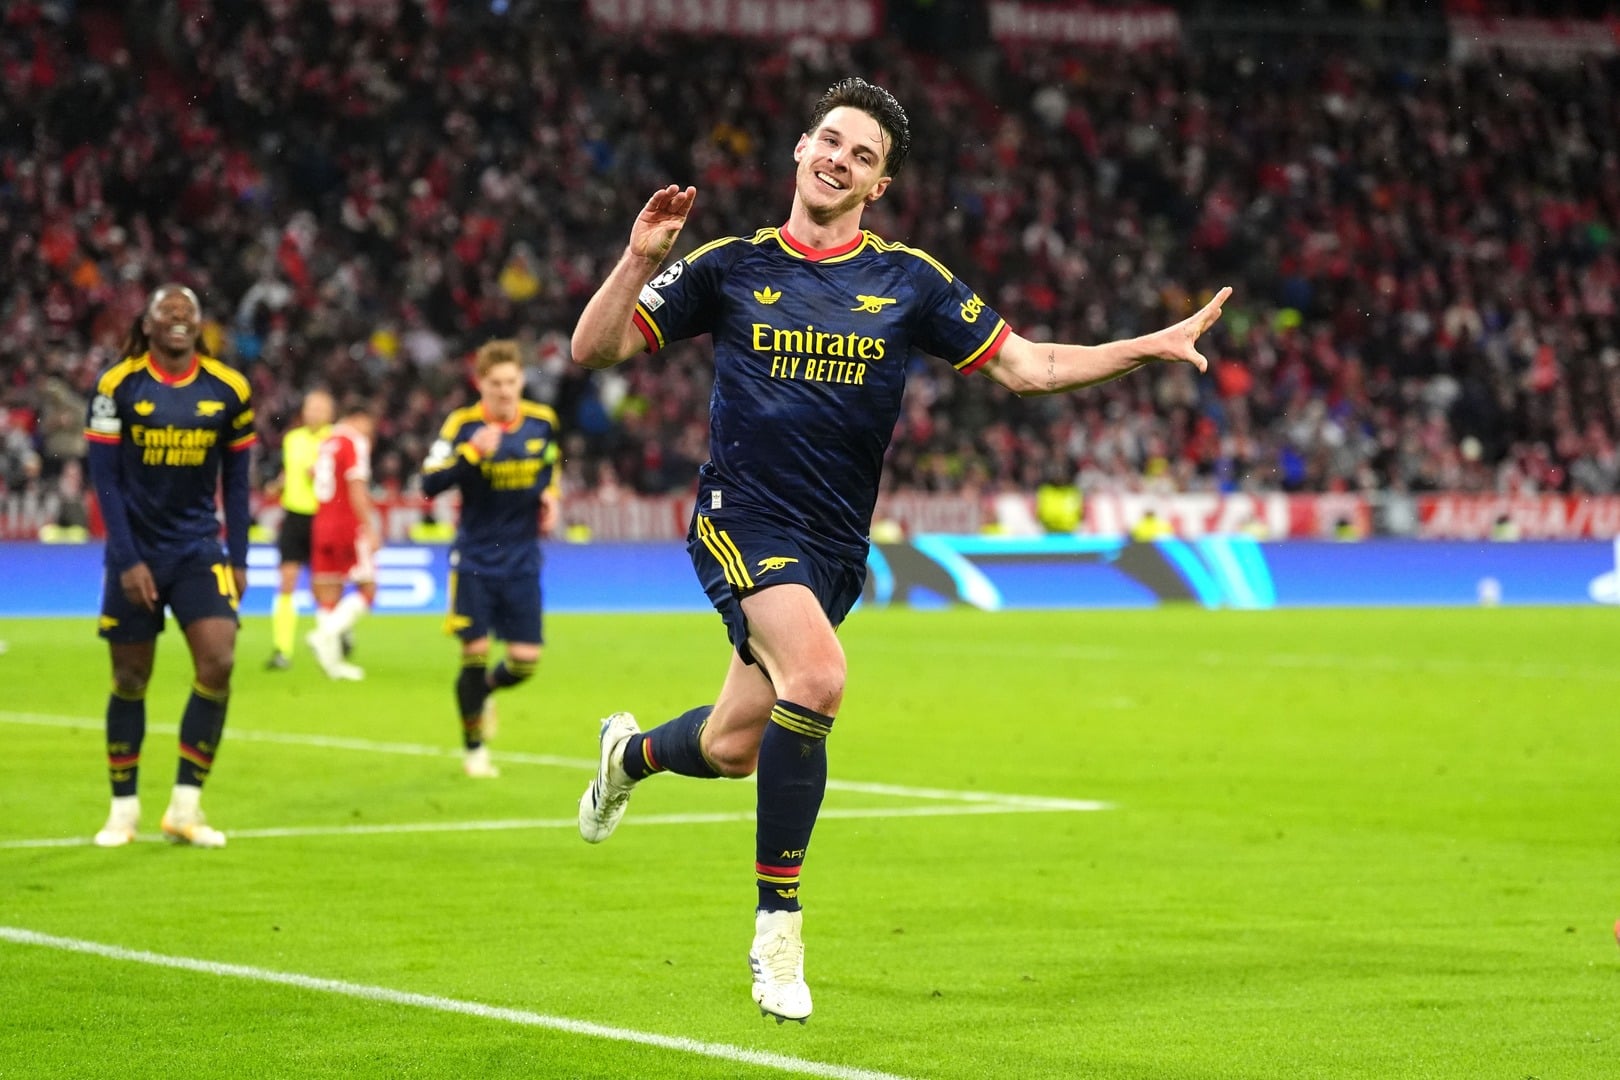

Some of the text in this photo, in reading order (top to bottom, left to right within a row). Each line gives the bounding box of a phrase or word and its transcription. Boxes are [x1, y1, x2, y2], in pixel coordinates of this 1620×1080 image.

[751, 323, 886, 360] Emirates
[770, 355, 866, 385] FLY BETTER
